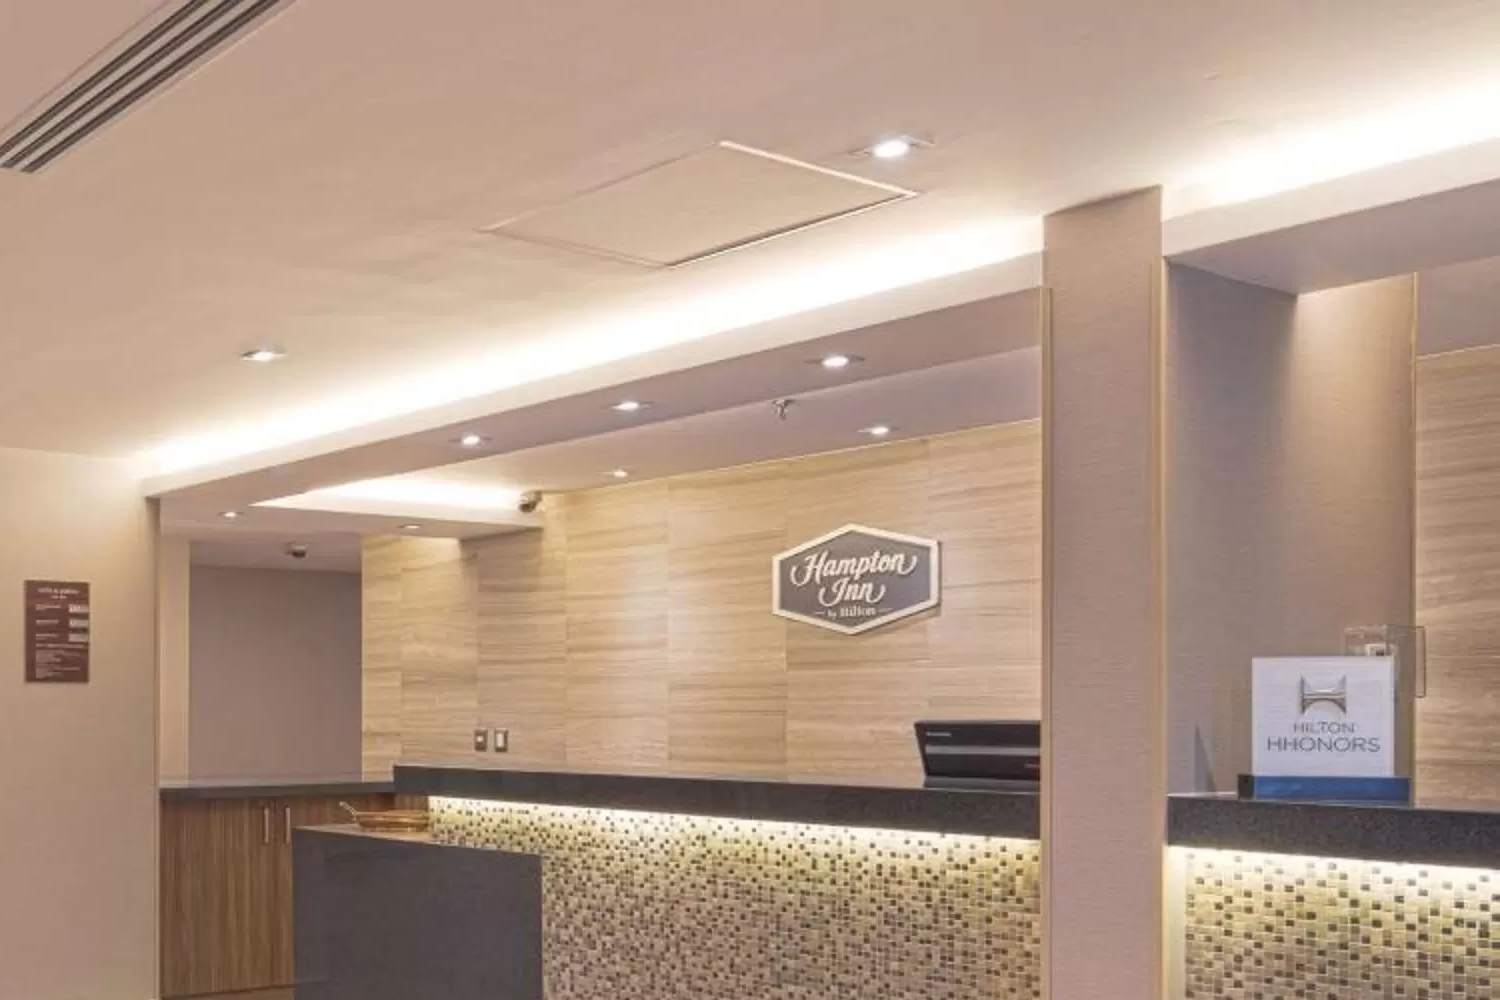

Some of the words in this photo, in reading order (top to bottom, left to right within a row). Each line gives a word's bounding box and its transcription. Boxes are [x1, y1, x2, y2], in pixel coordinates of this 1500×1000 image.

[790, 550, 918, 587] Hampton
[818, 577, 887, 607] Inn
[840, 606, 876, 617] Hilton
[1293, 721, 1355, 734] HILTON
[1267, 736, 1381, 753] HHONORS
